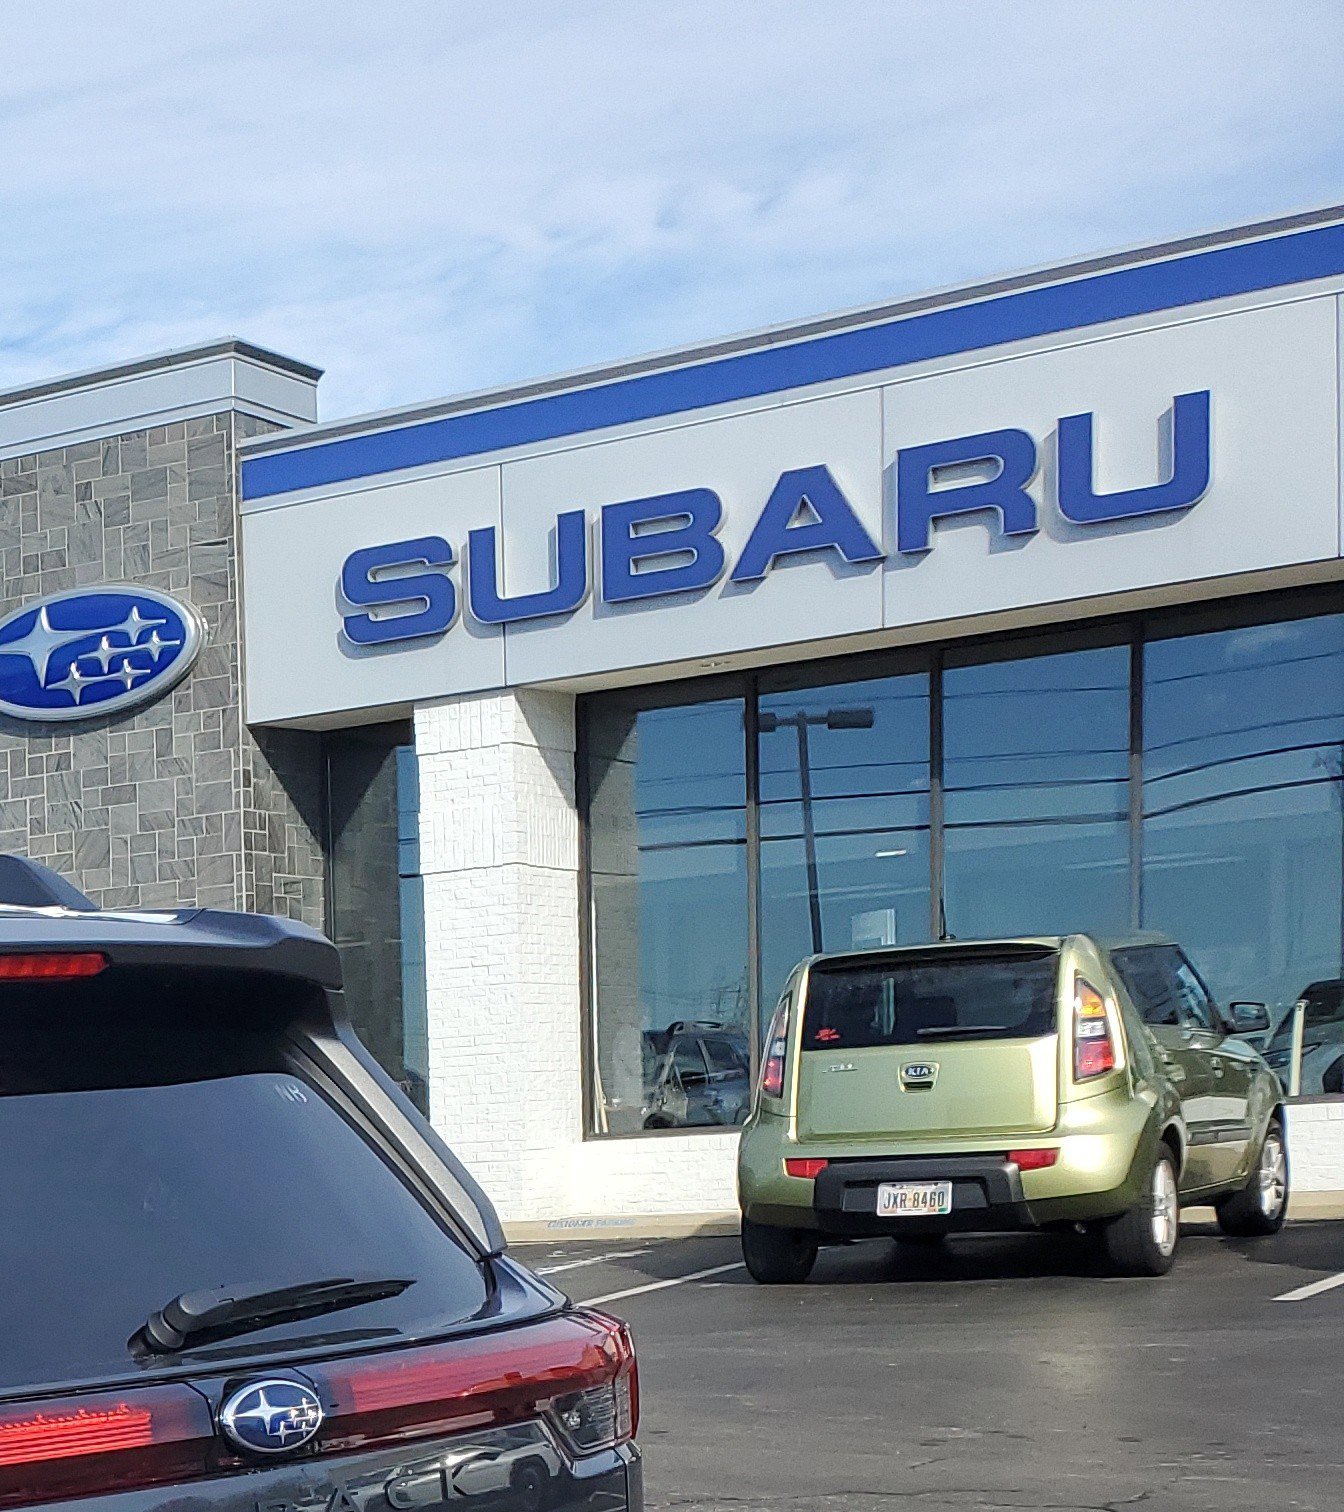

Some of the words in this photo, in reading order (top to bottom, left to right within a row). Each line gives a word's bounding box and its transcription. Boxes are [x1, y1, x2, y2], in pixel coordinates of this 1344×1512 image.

[340, 389, 1212, 646] SUBARU
[907, 1066, 929, 1076] KIA
[883, 1191, 908, 1209] JXR
[912, 1190, 945, 1208] 8460
